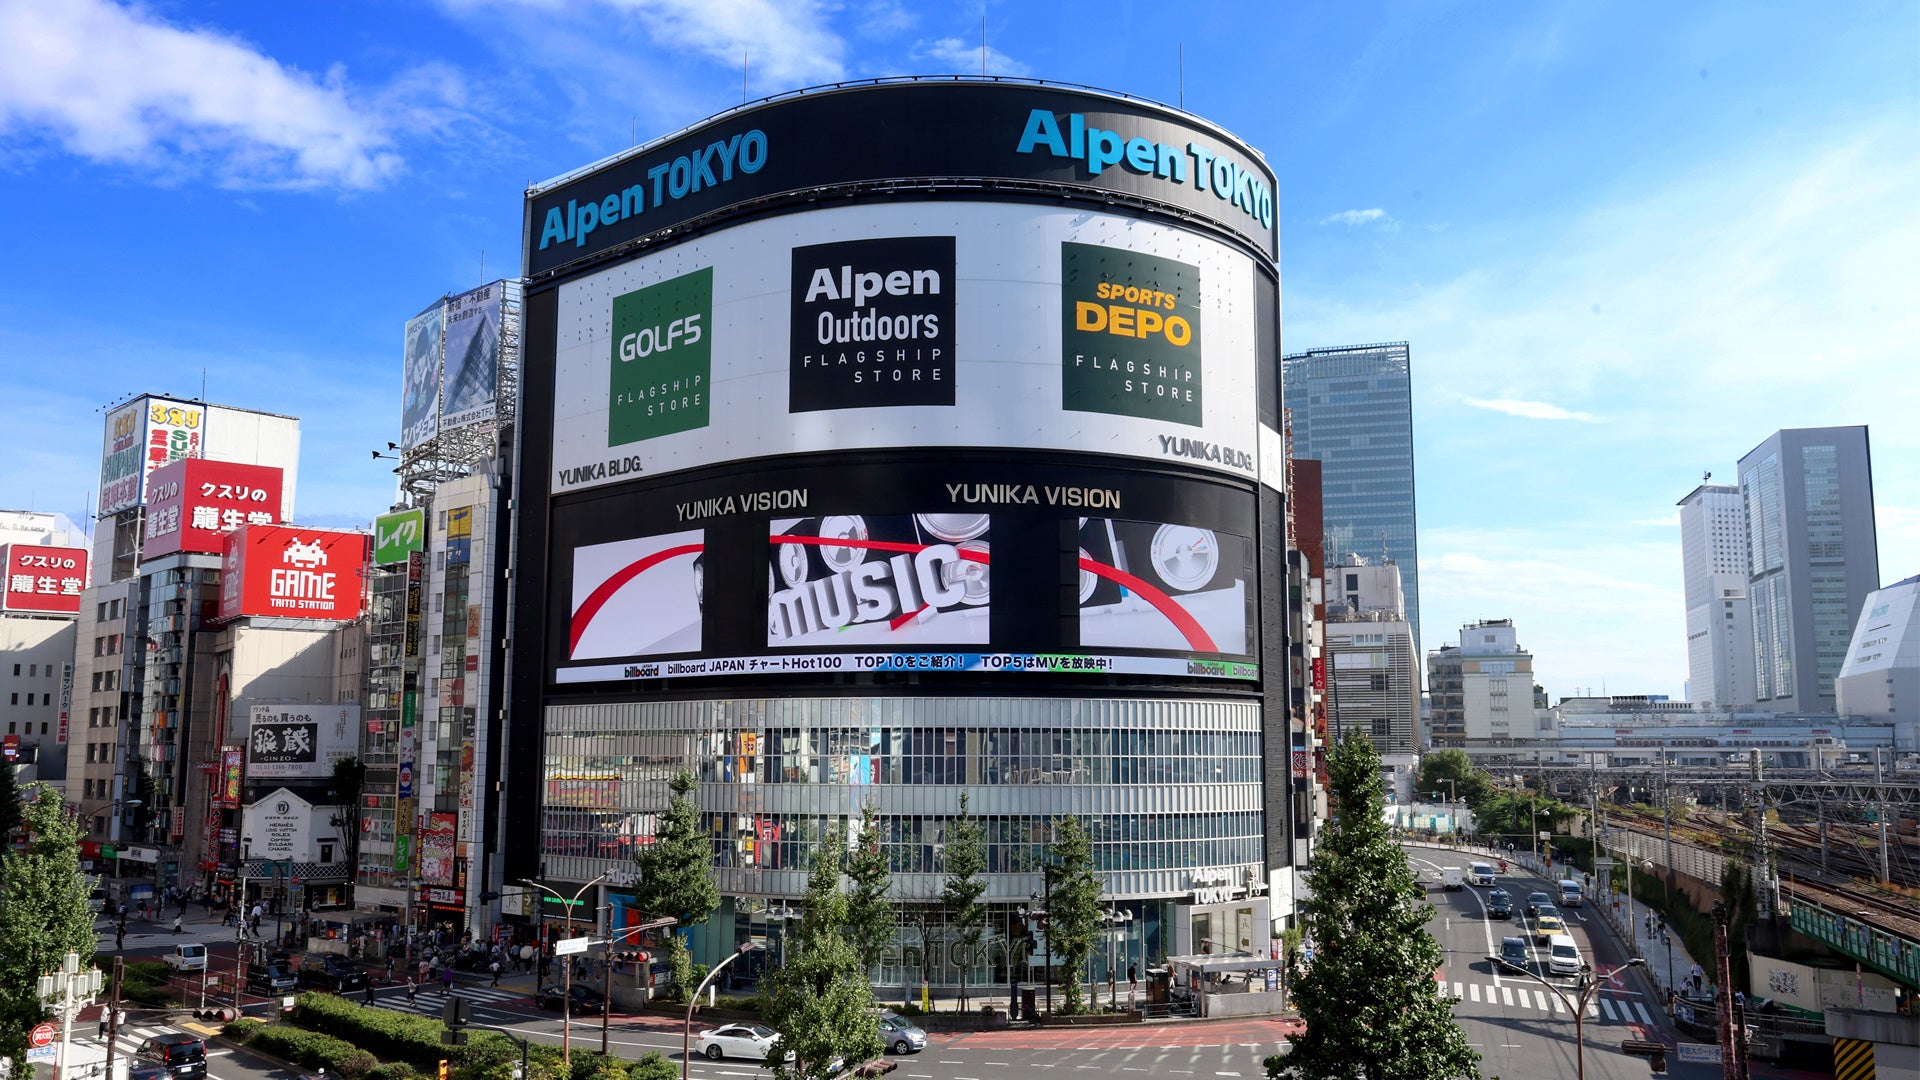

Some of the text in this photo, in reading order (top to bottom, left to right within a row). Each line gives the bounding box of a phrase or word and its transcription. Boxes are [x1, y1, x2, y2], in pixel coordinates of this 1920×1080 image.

[1016, 108, 1272, 230] Alpen TOKYO
[538, 129, 768, 252] Alpen TOKYO
[804, 265, 941, 307] Alpen
[1096, 282, 1176, 310] SPORTS
[817, 308, 939, 345] Outdoors
[1076, 301, 1192, 347] DEPO
[619, 314, 702, 363] GOLF5
[804, 348, 941, 368] FLAGSHIP
[1076, 355, 1192, 382] FLAGSHIP
[854, 367, 941, 384] STORE
[617, 375, 702, 407] FLAGSHIP
[1125, 380, 1192, 402] STORE
[647, 393, 702, 417] STORE
[1158, 434, 1221, 463] YUNIKA
[1223, 446, 1254, 472] BLDG.
[558, 455, 643, 487] YUNIKA BLDG.
[151, 481, 178, 504] クスリの
[200, 481, 267, 502] クスリの
[676, 488, 808, 522] YUNIKA VISION
[945, 483, 1121, 510] YUNIKA VISION
[378, 519, 417, 550] レイク
[20, 554, 76, 569] クスリの
[9, 574, 82, 596] 龍生堂
[270, 569, 336, 600] GAME
[270, 598, 335, 610] TAITO STATION
[624, 664, 659, 678] billboard
[667, 658, 706, 674] billboard
[709, 659, 745, 672] JAPAN
[749, 656, 842, 670] チャートHot100
[397, 840, 406, 864] レイク
[1193, 867, 1232, 885] Alpen
[1193, 886, 1233, 904] TOKYO
